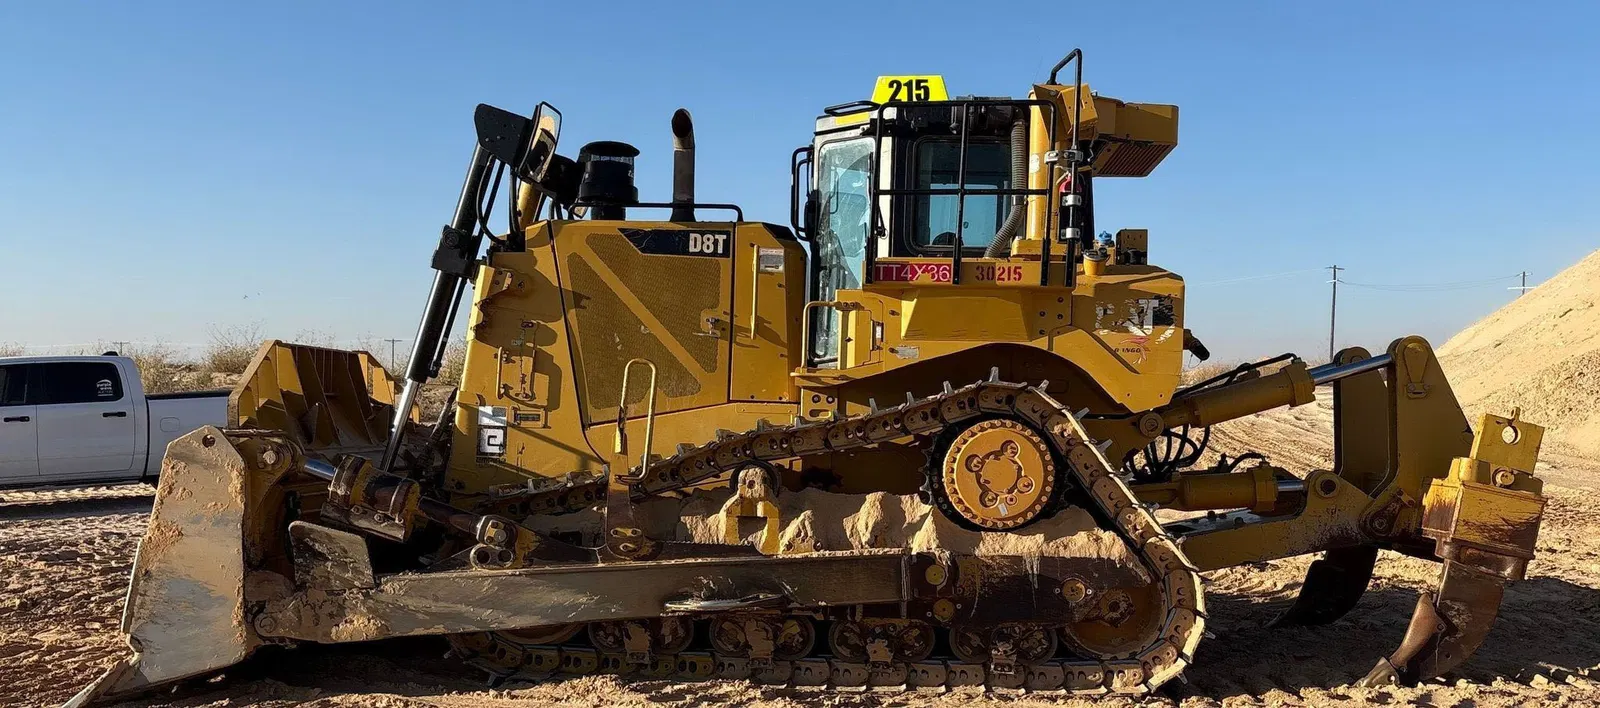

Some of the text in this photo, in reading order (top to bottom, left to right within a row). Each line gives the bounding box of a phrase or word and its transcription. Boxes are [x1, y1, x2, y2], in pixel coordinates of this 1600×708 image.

[888, 79, 930, 102] 215
[689, 233, 727, 254] D8T
[975, 265, 1022, 282] 30215
